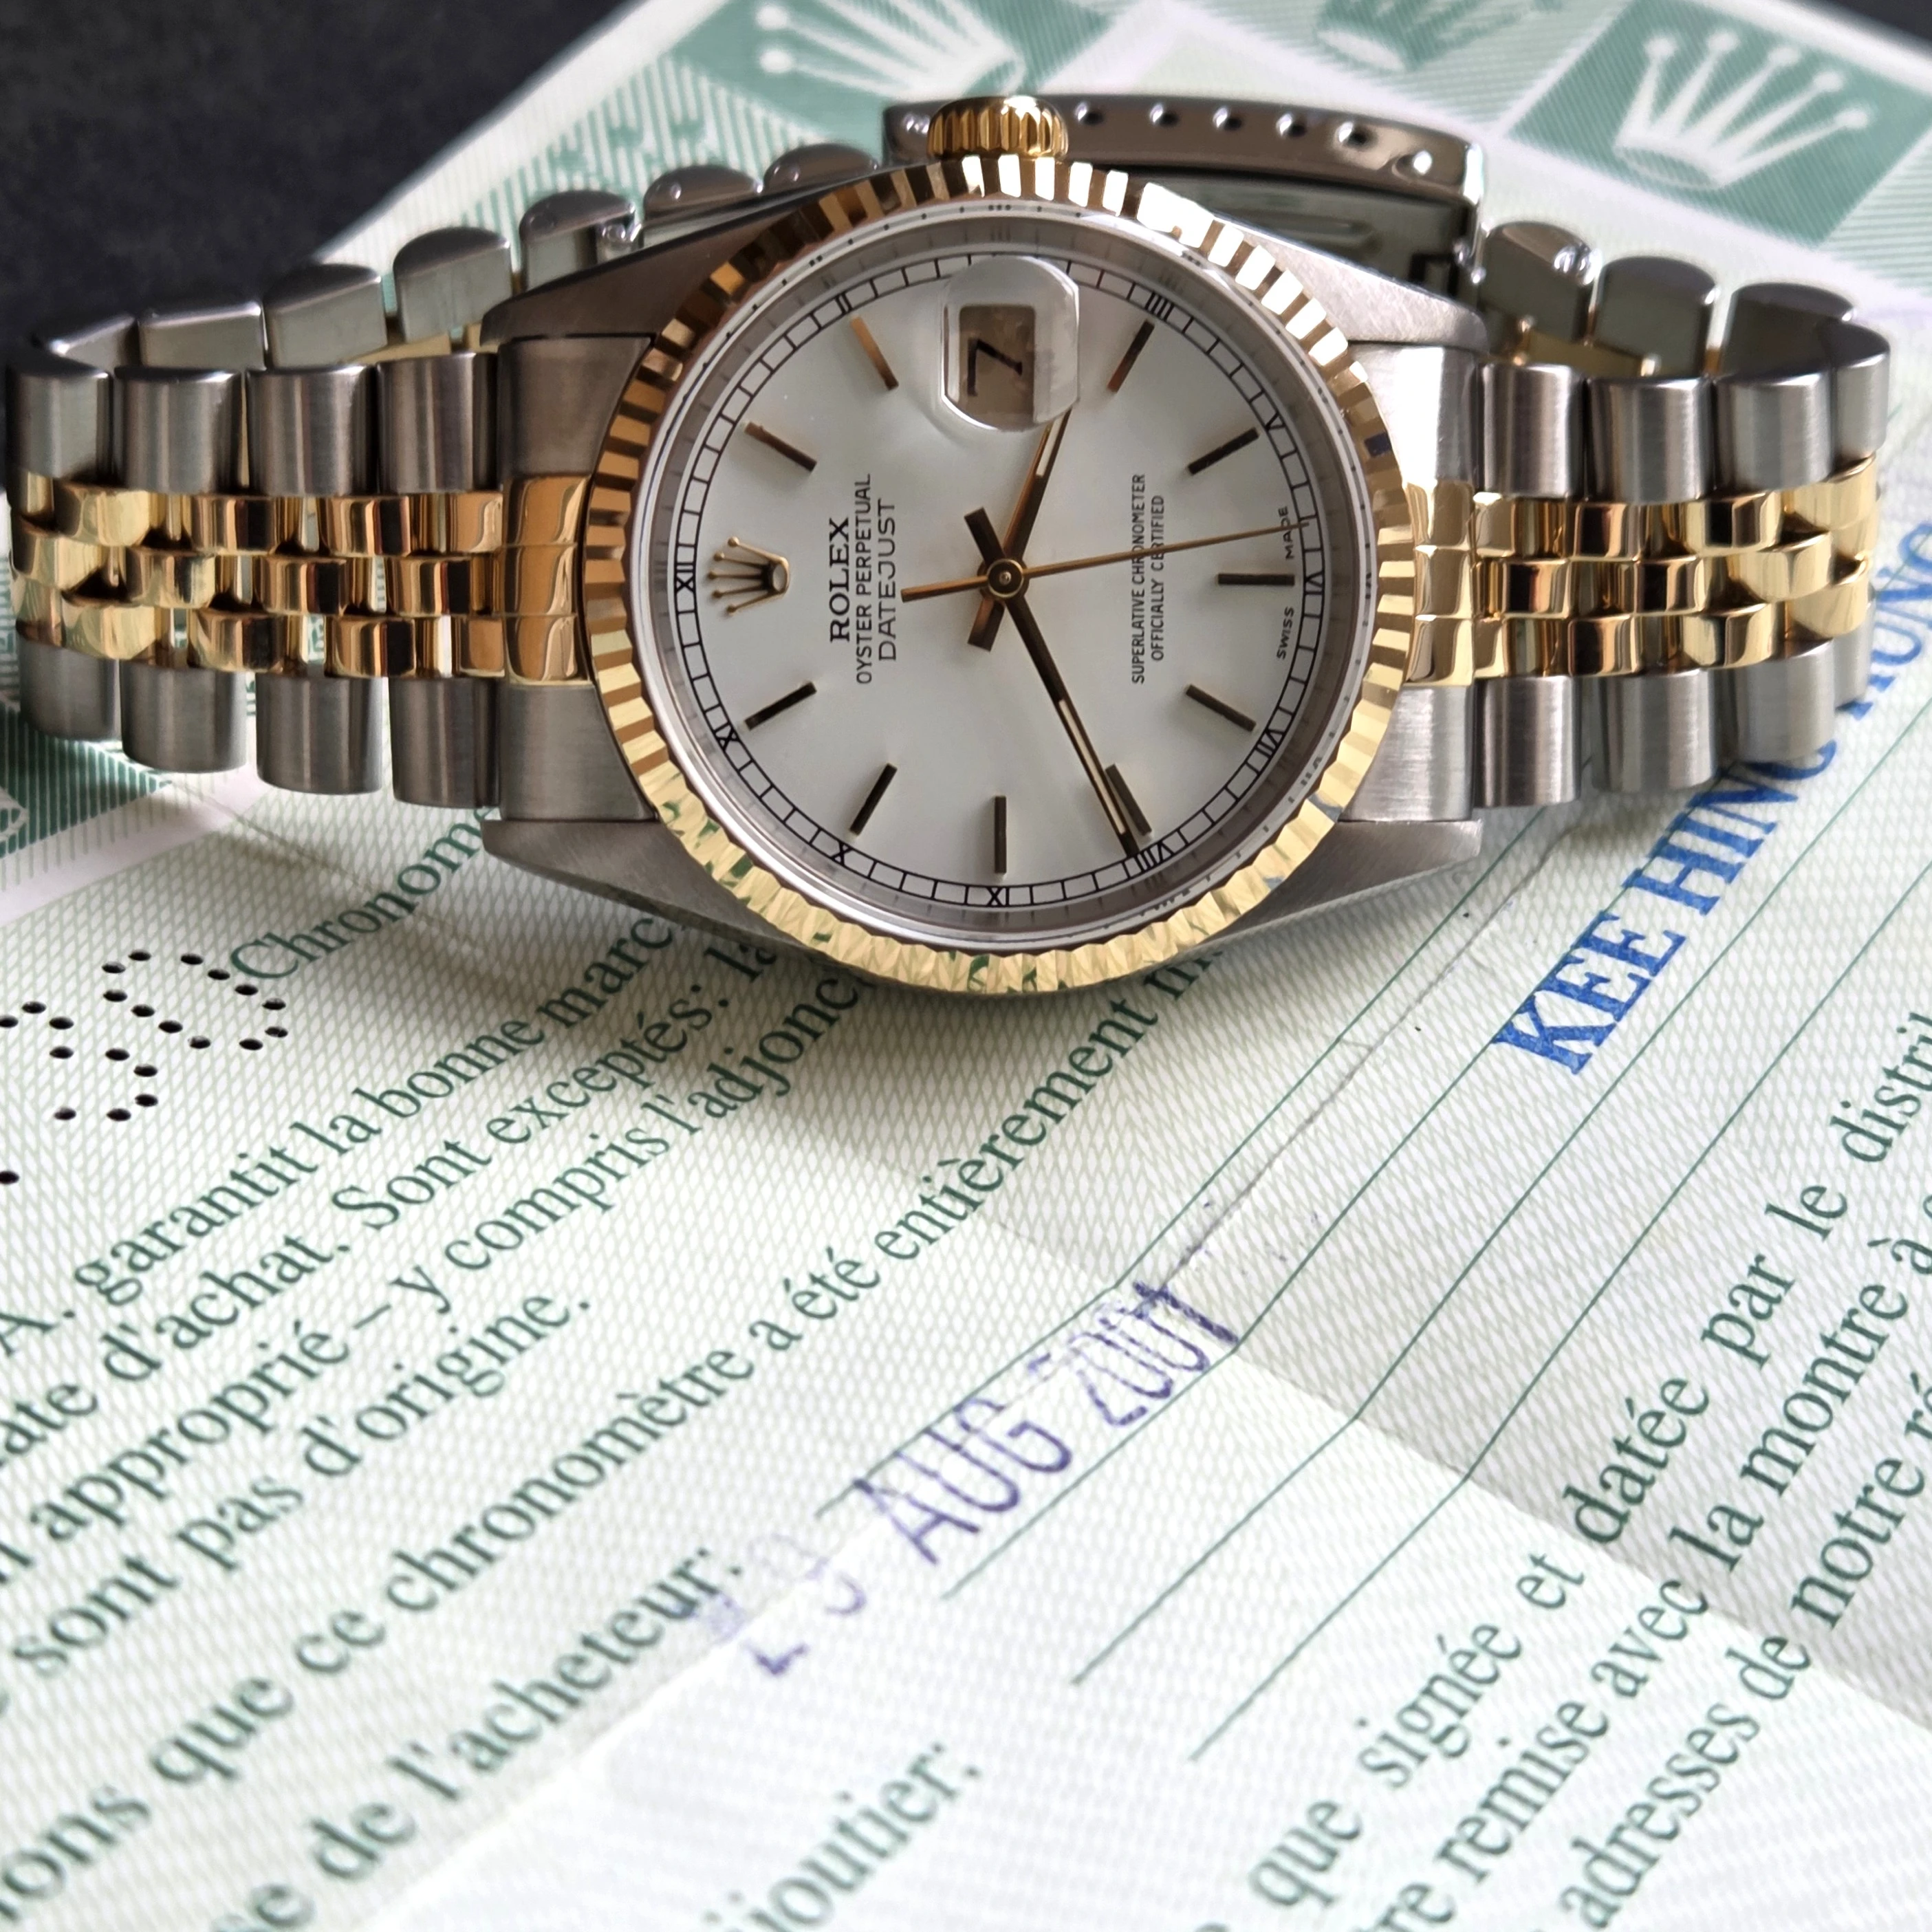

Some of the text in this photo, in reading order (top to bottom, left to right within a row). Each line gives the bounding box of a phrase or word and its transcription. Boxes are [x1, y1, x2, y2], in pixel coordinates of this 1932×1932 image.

[828, 517, 850, 642] ROLEX
[855, 473, 872, 684] OYSTER PERPETUAL
[878, 498, 896, 661] DATEJUST
[1131, 474, 1145, 684] SUPERLATIVE CHRONOMETER
[1151, 495, 1164, 662] OFFICIALLY CERTIFIED
[1277, 506, 1294, 660] SWISS MADE
[229, 807, 494, 979] Chronom
[1489, 910, 1687, 1075] KEE
[0, 1385, 98, 1466] ate
[100, 1234, 351, 1382] d'achat.
[331, 1139, 493, 1231] Sont
[486, 983, 729, 1145] exceptés:
[30, 1319, 351, 1541] approprié
[389, 1264, 452, 1315] y
[444, 1127, 671, 1271] compris
[640, 971, 876, 1136] l'adjonc
[74, 1146, 318, 1306] garantit
[288, 1114, 383, 1155] la
[351, 1019, 546, 1120] bonne
[536, 918, 686, 1030] marc
[14, 1295, 591, 1679] sont pas d'origine.
[149, 1677, 296, 1785] que
[294, 1609, 387, 1676] ce
[385, 1349, 755, 1612] chronomètre
[748, 1319, 805, 1352] a
[782, 1246, 881, 1321] été
[873, 998, 1160, 1261] entièrement
[853, 1396, 1072, 1565] AUG
[1028, 1279, 1239, 1427] 2001
[1246, 1799, 1363, 1908] que
[1354, 1622, 1523, 1789] signée
[1515, 1552, 1585, 1610] et
[1562, 1376, 1711, 1545] datée
[1700, 1253, 1797, 1371] par
[1763, 1184, 1849, 1241] le
[310, 1546, 744, 1882] de l'acheteur:
[1433, 1700, 1610, 1883] remise
[1589, 1578, 1710, 1700] avec
[1669, 1503, 1765, 1574] la
[1739, 1283, 1909, 1497] montre
[1866, 1236, 1932, 1275] à
[1557, 1457, 1926, 1931] adresses de notre
